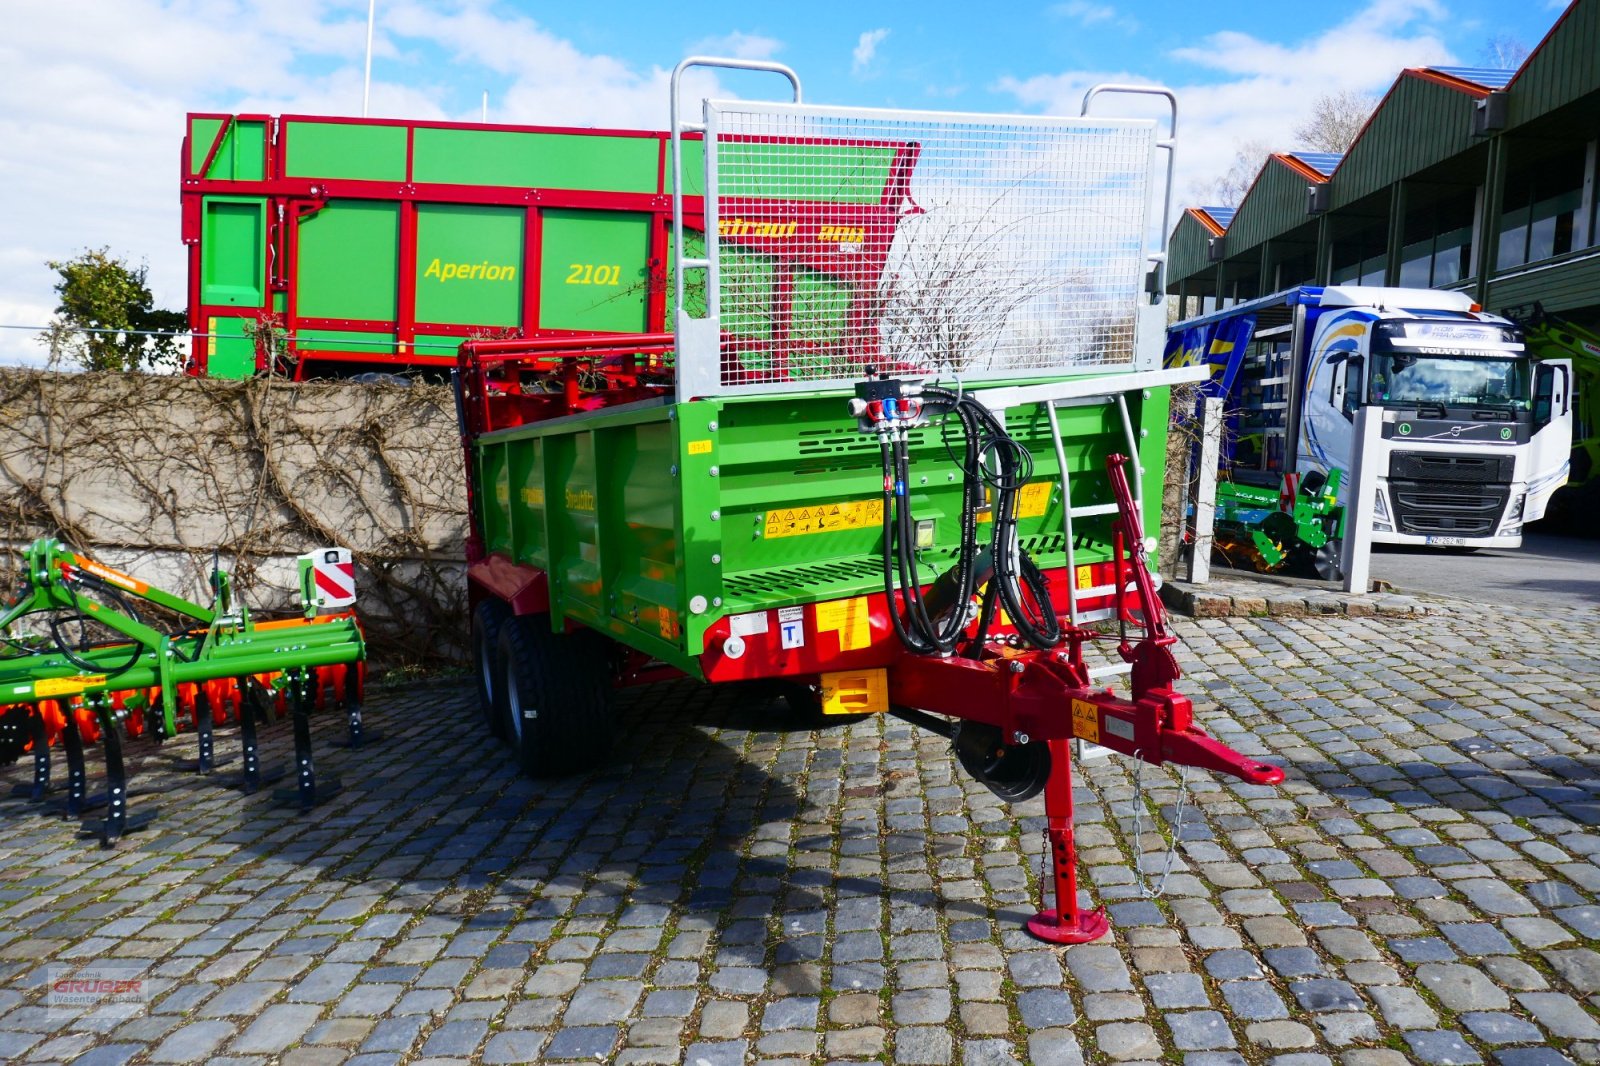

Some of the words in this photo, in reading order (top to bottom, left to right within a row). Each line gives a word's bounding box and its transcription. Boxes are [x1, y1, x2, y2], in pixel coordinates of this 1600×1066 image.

[424, 258, 515, 282] Aperion
[565, 264, 621, 285] 2101
[1419, 347, 1461, 355] VOLVO
[783, 626, 796, 642] T
